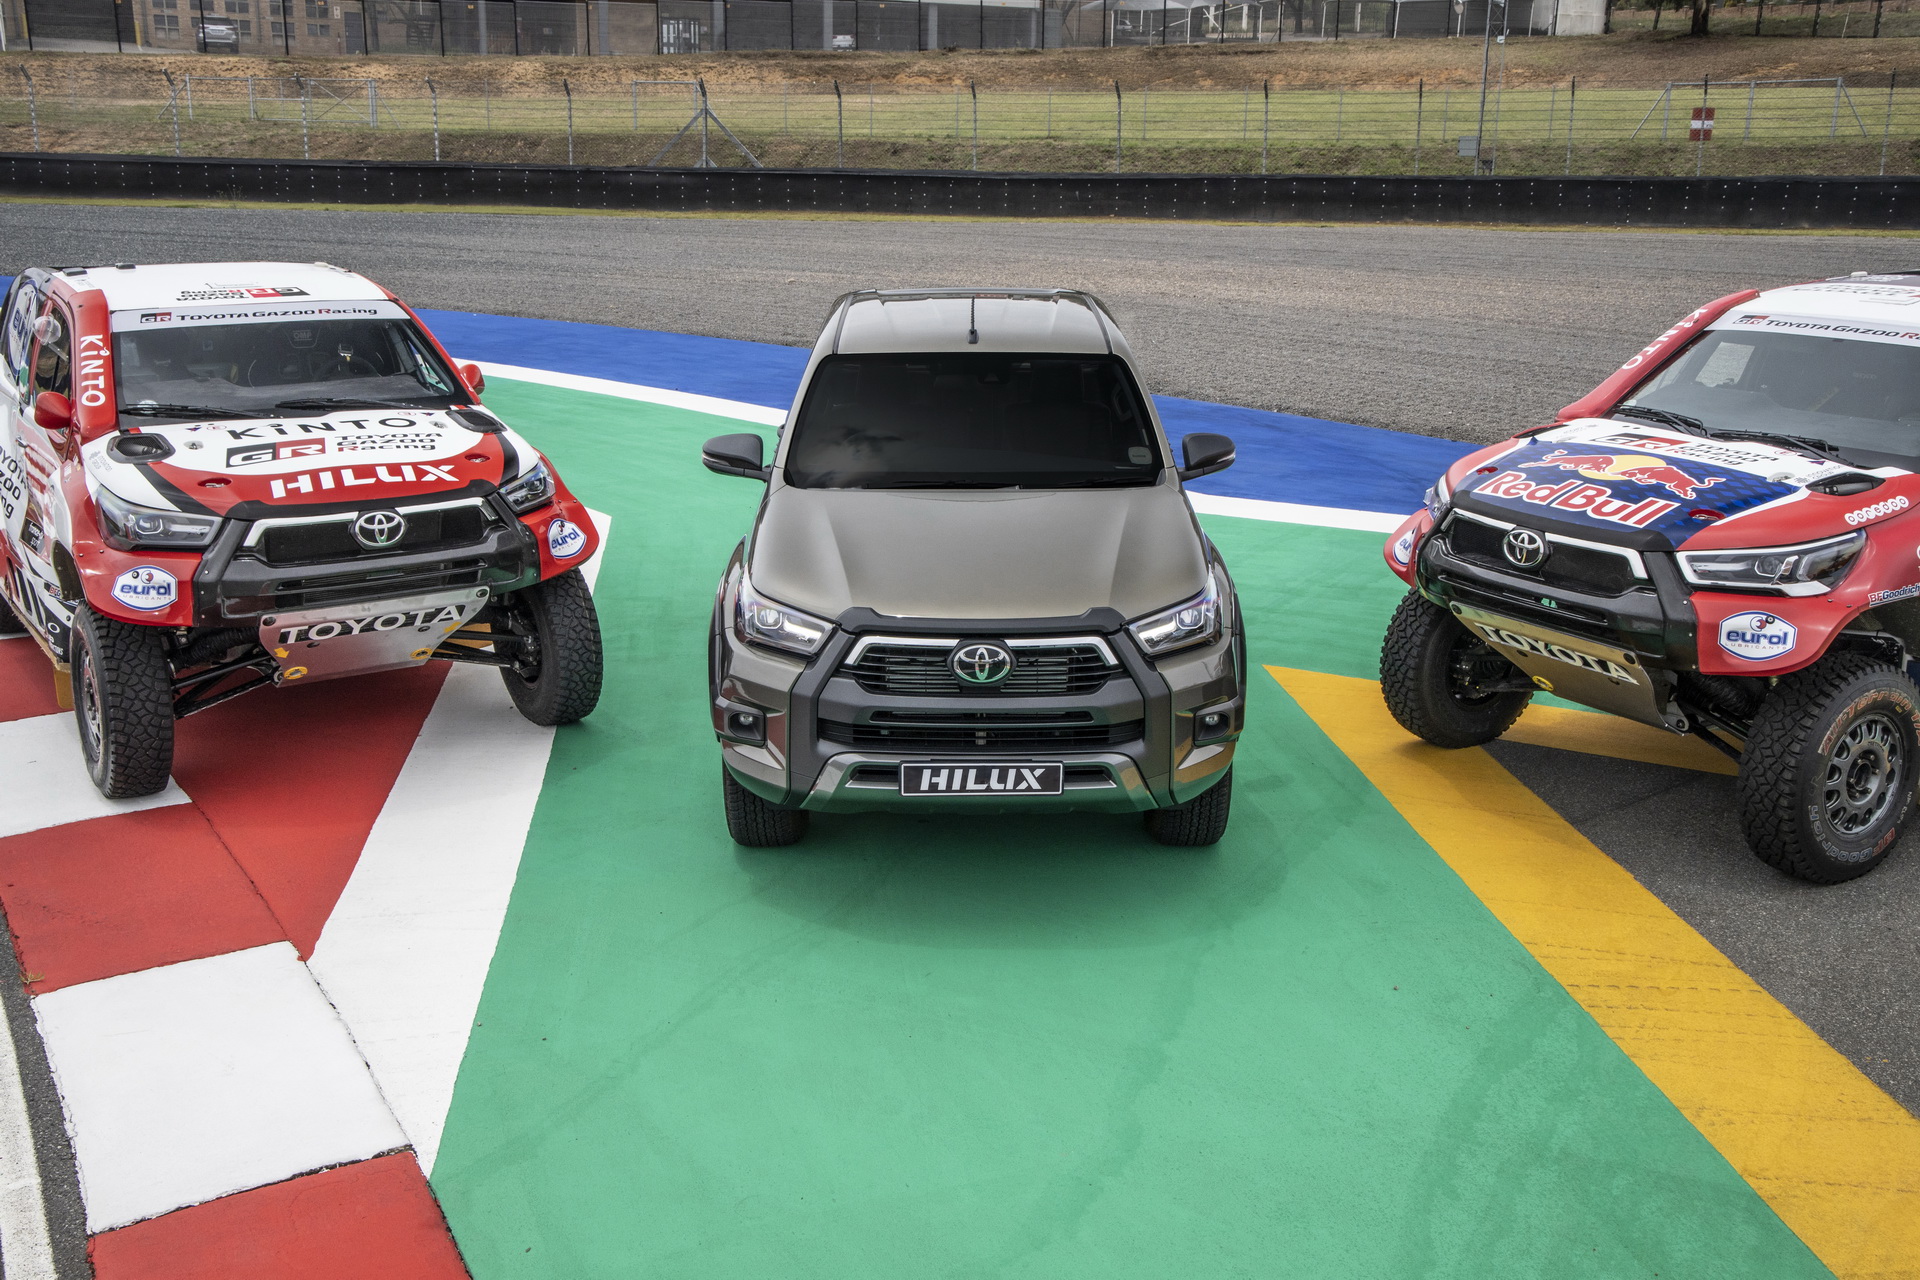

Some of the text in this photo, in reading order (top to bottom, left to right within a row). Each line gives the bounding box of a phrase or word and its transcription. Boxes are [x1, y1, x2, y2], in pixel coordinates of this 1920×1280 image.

[140, 307, 378, 323] GR TOYOTA GAZOO Racing
[1735, 316, 1767, 325] GR
[1765, 319, 1832, 331] TOYOTA
[1832, 325, 1900, 337] GAZOO
[334, 432, 443, 441] TOYOTA
[336, 438, 436, 446] GAZOO
[1592, 434, 1685, 449] GR
[228, 440, 324, 467] GR
[337, 444, 436, 452] Racing
[1664, 448, 1743, 466] Racing
[1677, 445, 1760, 463] GAZOO
[1694, 443, 1780, 461] TOYOTA
[270, 464, 460, 499] HILUX
[1474, 471, 1680, 527] Red Bull
[1846, 497, 1908, 524] ooredoo
[551, 527, 580, 549] eurol
[120, 582, 171, 596] eurol
[1870, 583, 1920, 603] BFGoodrich
[280, 605, 462, 644] TOYOTA
[1726, 630, 1789, 645] eurol
[1474, 622, 1640, 686] TOYOTA
[920, 768, 1046, 791] HILUX
